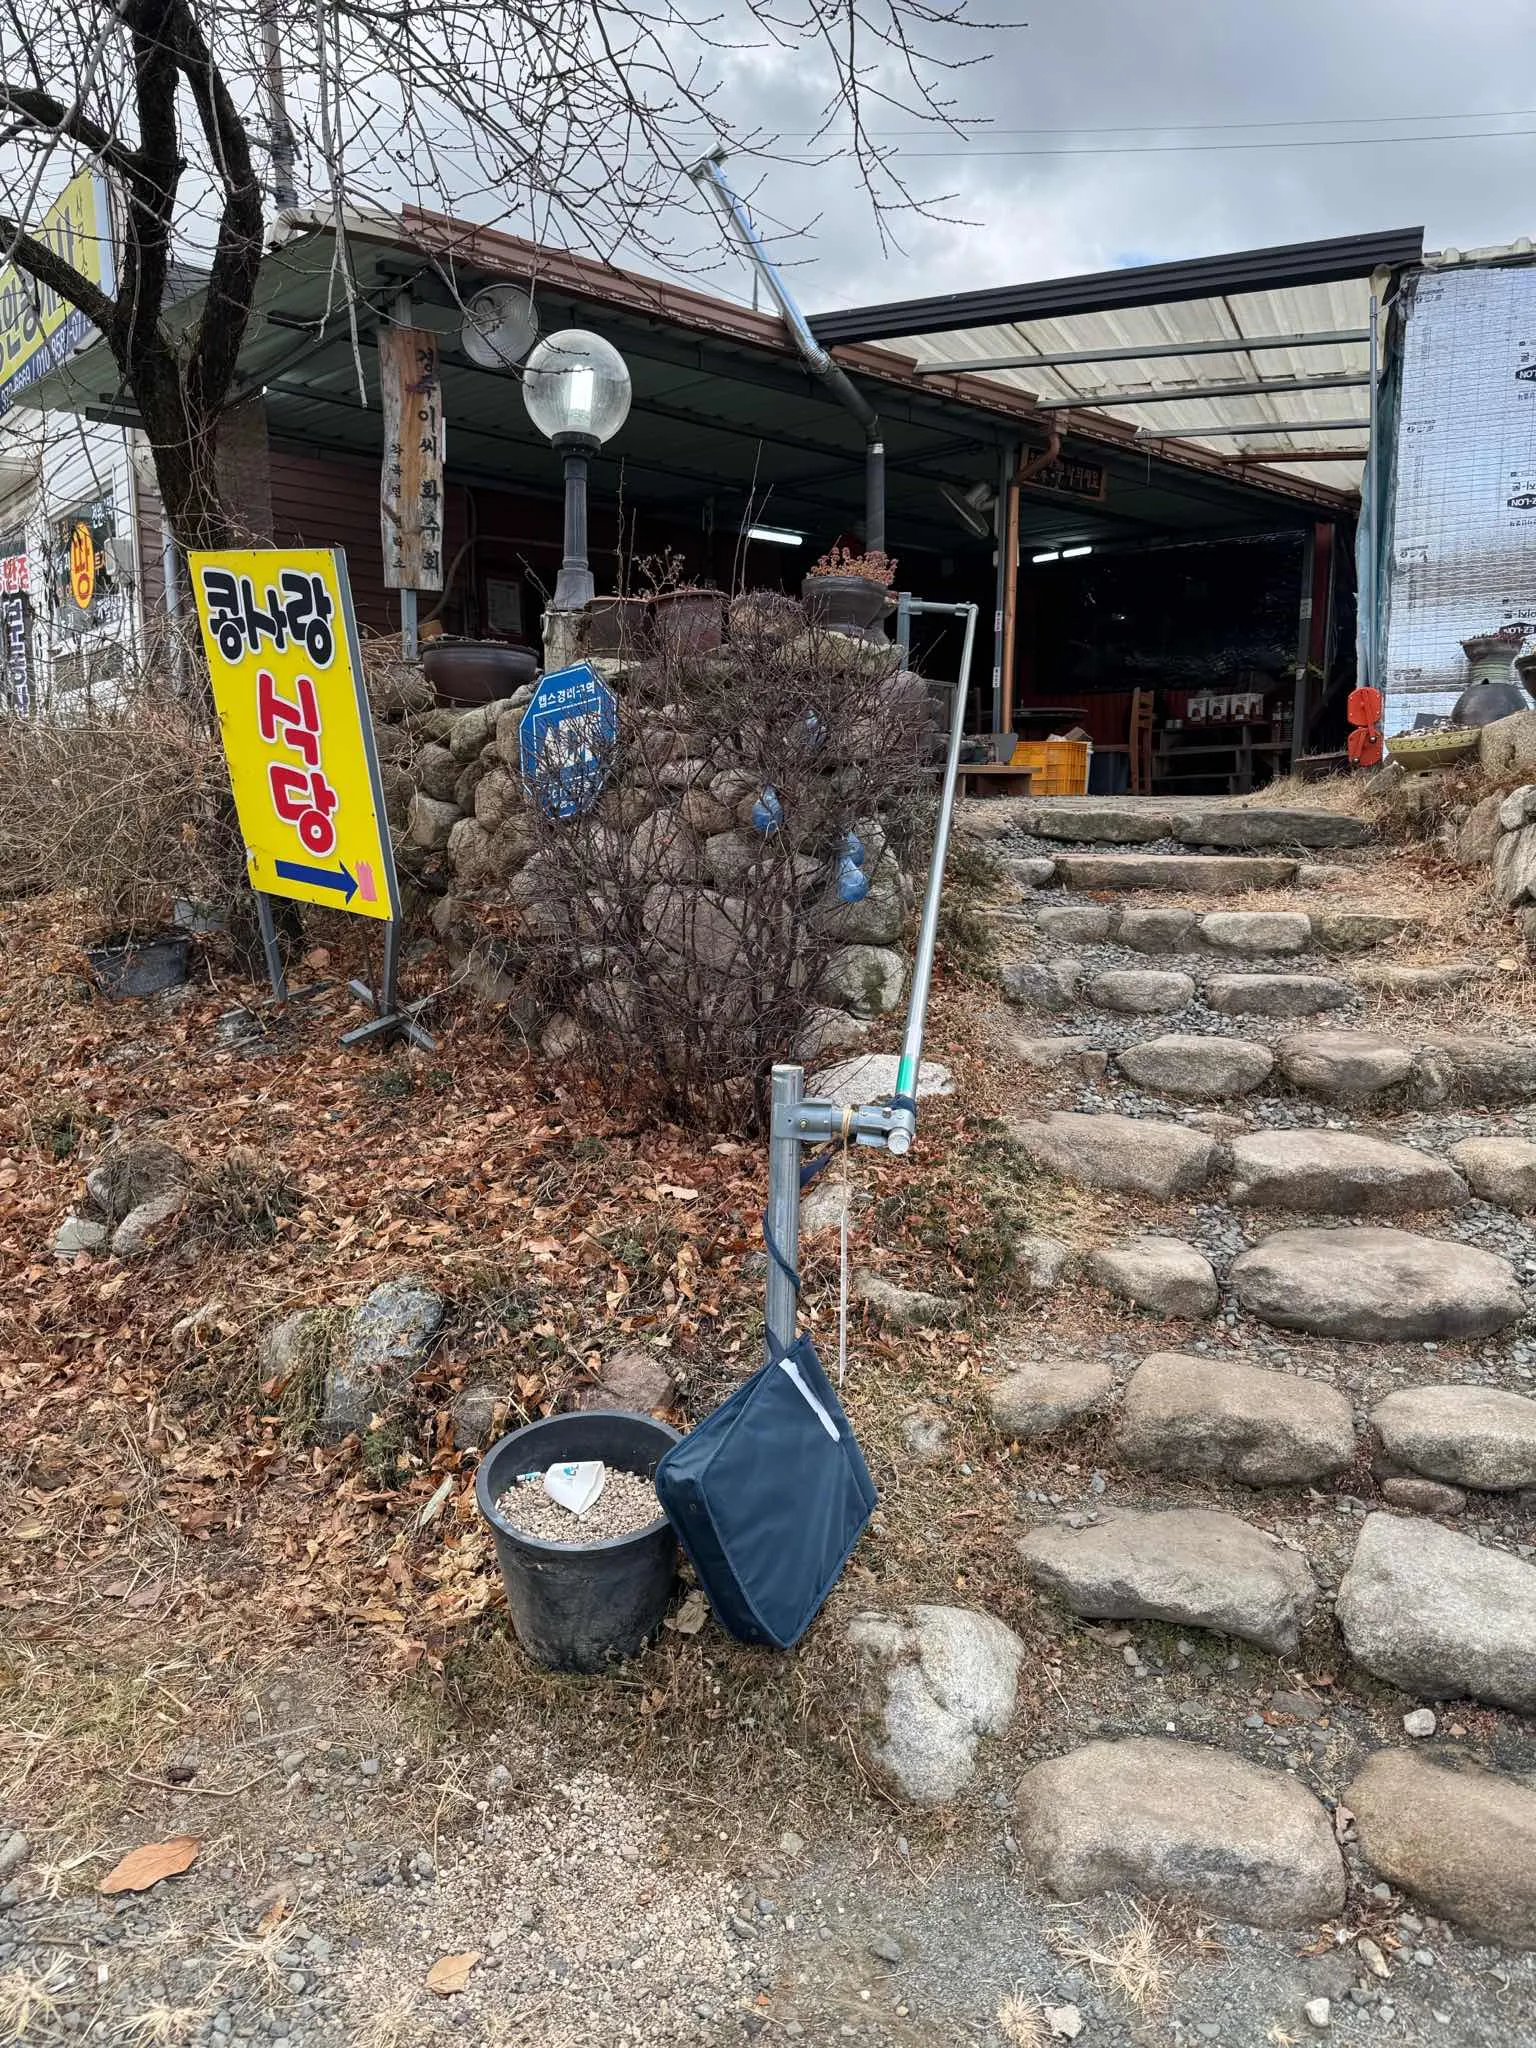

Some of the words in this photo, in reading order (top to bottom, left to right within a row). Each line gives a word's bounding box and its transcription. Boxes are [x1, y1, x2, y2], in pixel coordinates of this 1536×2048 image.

[203, 568, 334, 668] 콩사랑
[538, 682, 596, 708] 캡스경비구역
[258, 670, 337, 856] 식당
